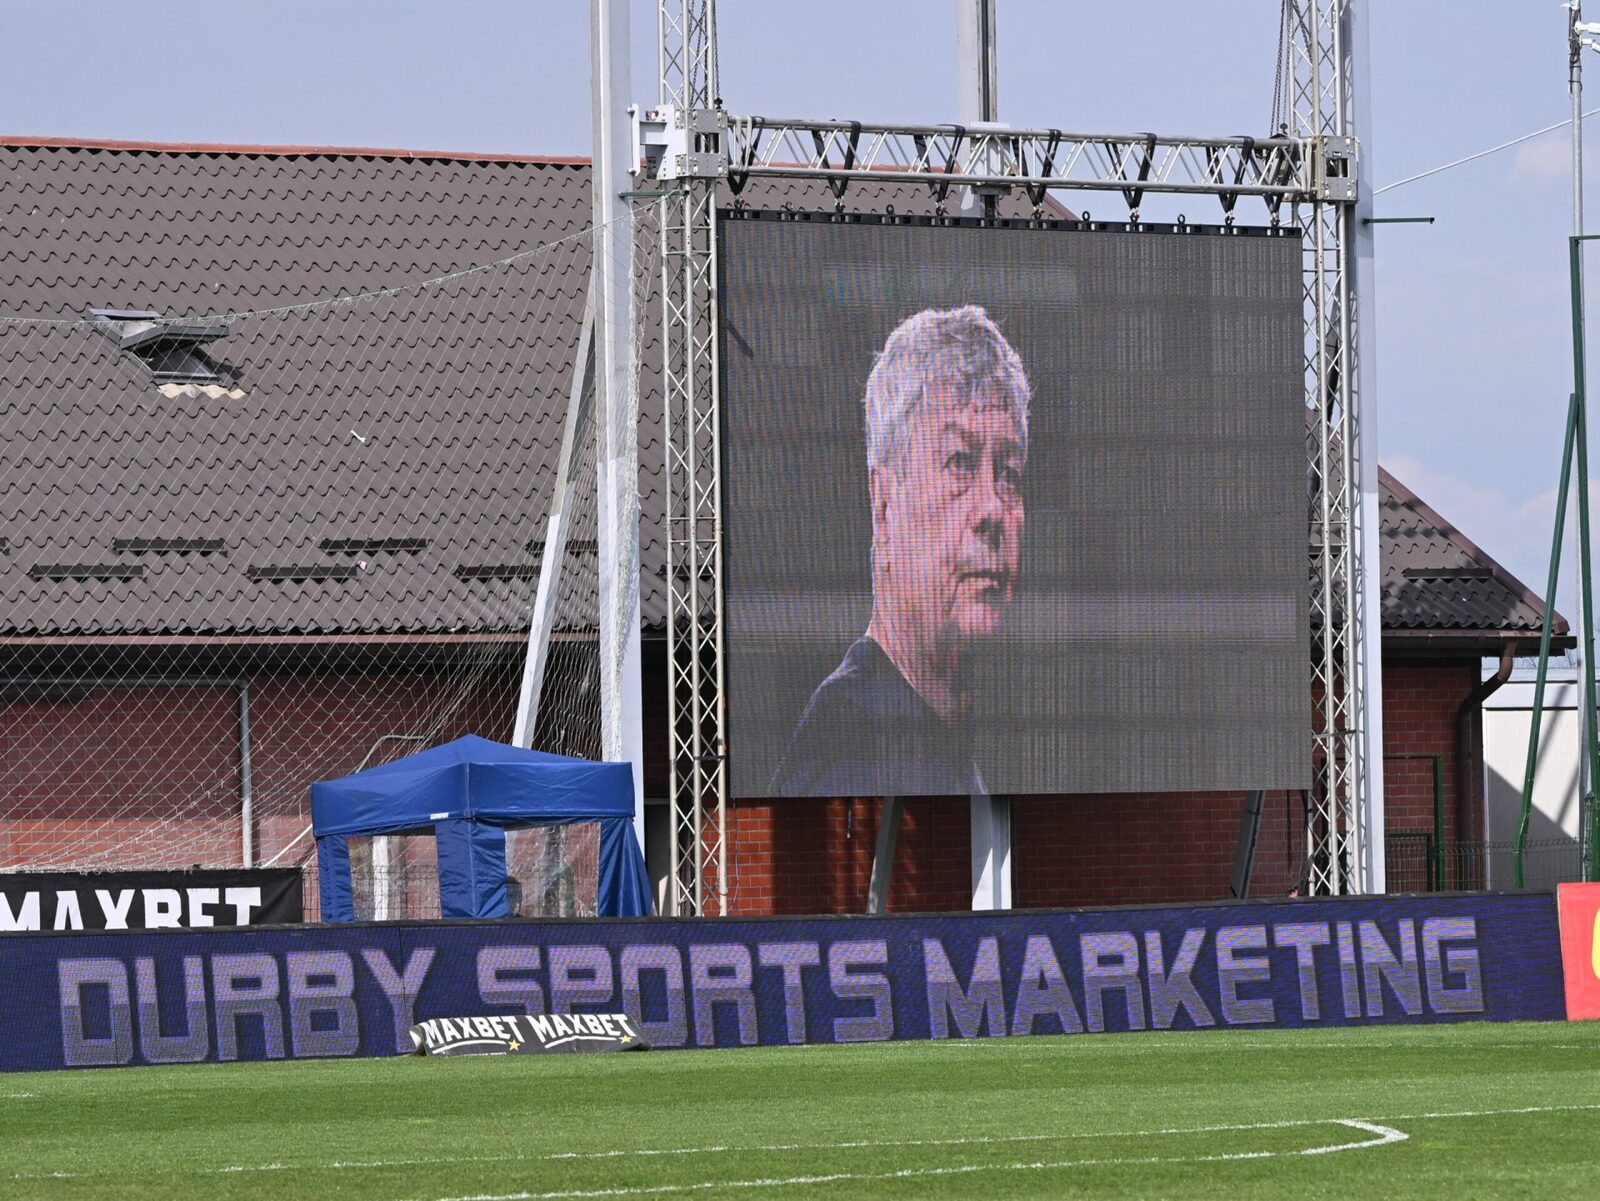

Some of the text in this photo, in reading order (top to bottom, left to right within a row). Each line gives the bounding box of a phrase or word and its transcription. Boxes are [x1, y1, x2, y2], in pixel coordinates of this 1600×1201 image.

[57, 916, 1485, 1067] DURBY SPORTS MARKETING
[422, 1013, 636, 1048] MAXBET MAXBET
